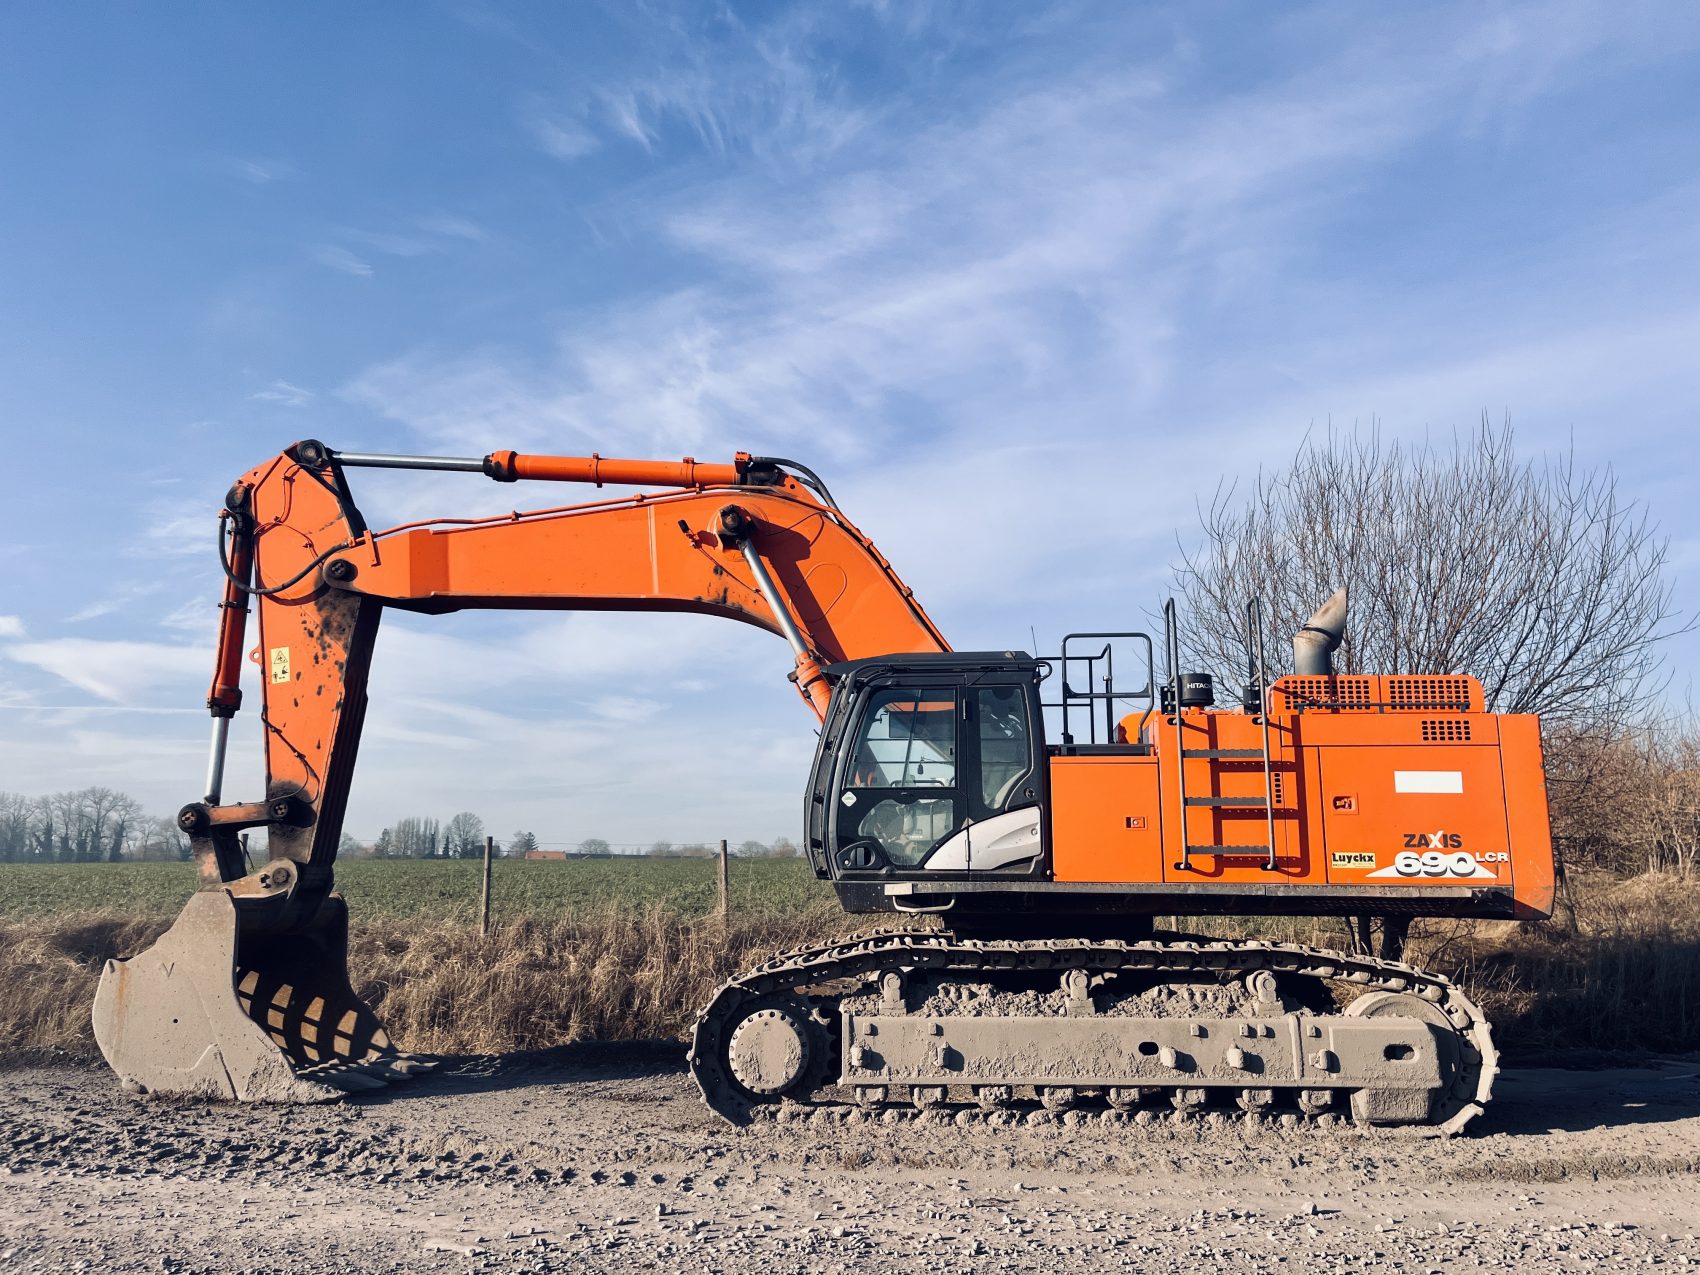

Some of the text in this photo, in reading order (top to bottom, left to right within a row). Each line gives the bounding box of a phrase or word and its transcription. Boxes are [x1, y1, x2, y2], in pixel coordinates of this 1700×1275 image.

[1403, 830, 1462, 848] ZAXIS
[1332, 852, 1374, 864] Luyckx
[1395, 851, 1508, 877] 690 LCR
